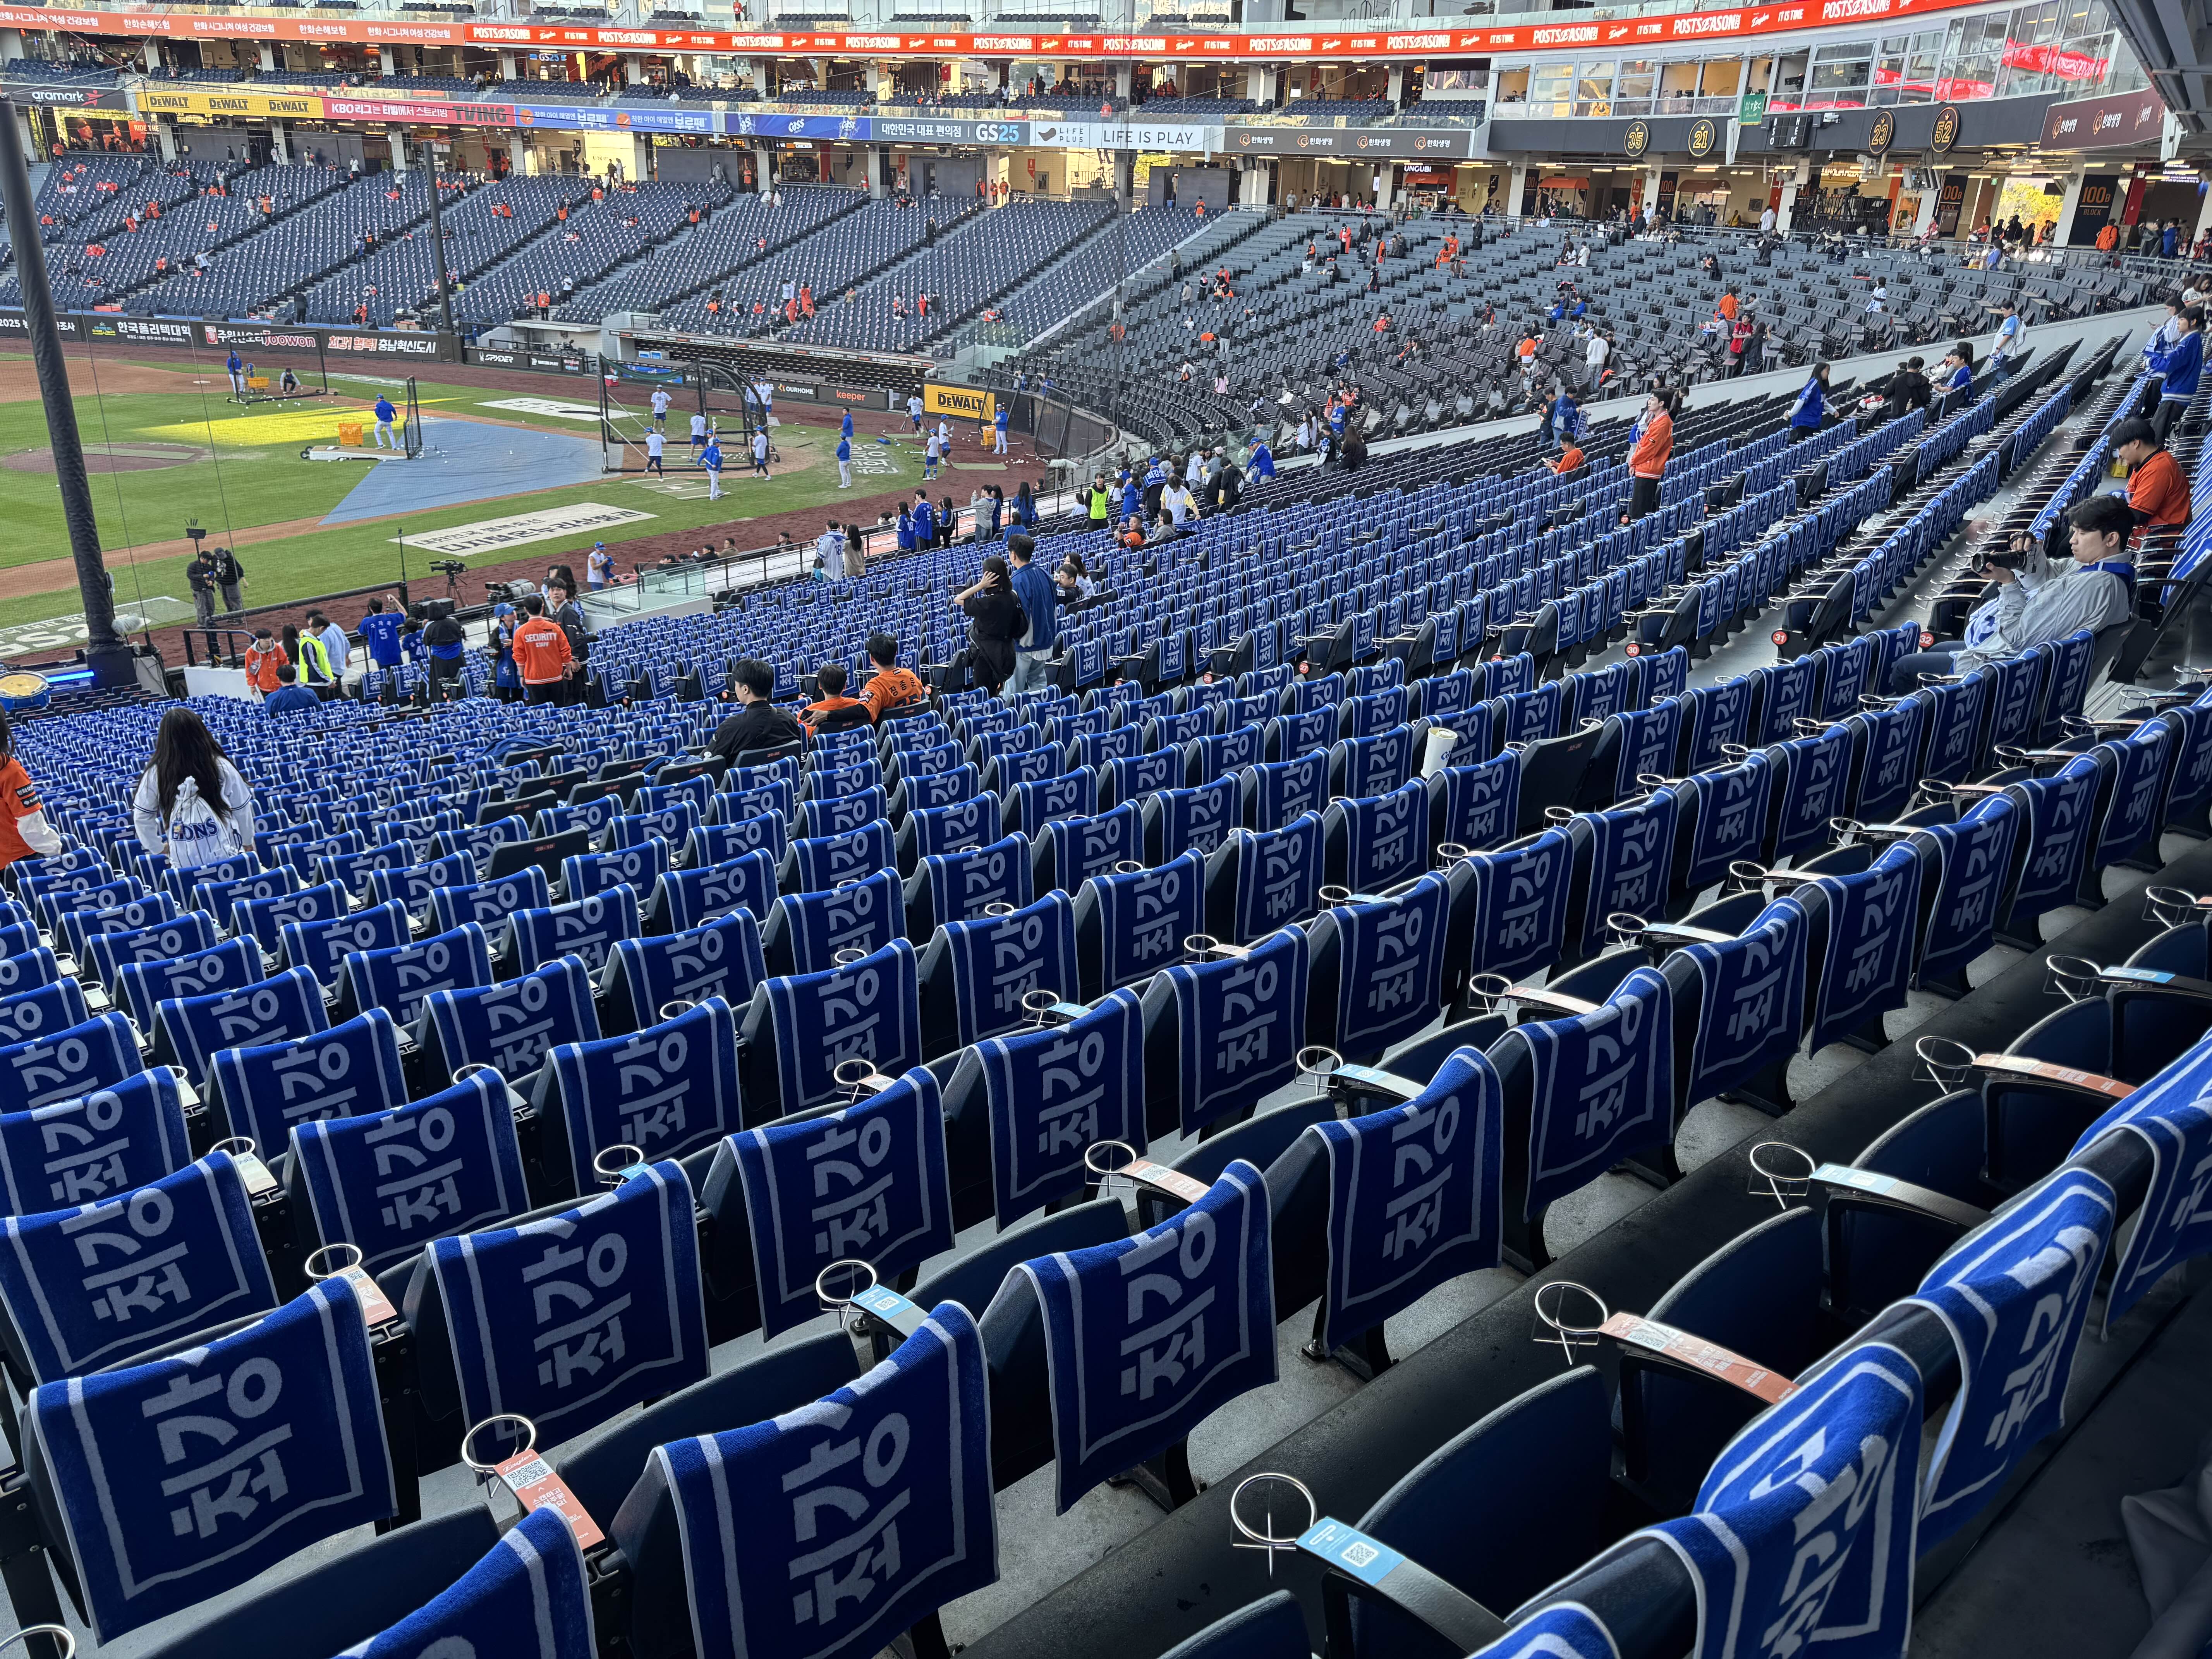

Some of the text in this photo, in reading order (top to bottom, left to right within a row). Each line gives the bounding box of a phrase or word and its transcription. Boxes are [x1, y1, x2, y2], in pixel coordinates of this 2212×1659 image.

[15, 14, 48, 23] 시그니처
[49, 15, 65, 24] 여성
[67, 16, 98, 26] 건강보험
[124, 19, 170, 30] 한화손해보험
[194, 22, 275, 33] 한화 시그니처 여성 건강보험
[1673, 16, 1735, 35] POSTSEASON
[299, 25, 346, 36] 한화손해보험
[368, 27, 450, 39] 한화 시그니처 여성 건강보험
[1533, 27, 1593, 44] POSTSEASON
[32, 91, 85, 102] aramark
[150, 96, 189, 108] DEWALT
[209, 99, 248, 110] DEWALT
[269, 101, 309, 112] DEWALT
[331, 104, 448, 117] KBO 리그는 티빙에서 스트리밍
[453, 106, 507, 123] TVING
[577, 113, 608, 128] 부루펜
[2102, 113, 2122, 129] 한화생명
[882, 123, 1019, 142] 대한민국 대표 편의점 GS25
[1104, 130, 1193, 144] LIFE IS PLAY
[1772, 127, 1775, 136] S
[1794, 127, 1798, 135] E
[1871, 124, 1889, 145] 23
[1934, 120, 1953, 143] 52
[1252, 136, 1273, 144] 한화생명
[1310, 137, 1333, 146] 한화생명
[1369, 138, 1391, 147] 한화생명
[1427, 139, 1450, 148] 한화생명
[1628, 132, 1644, 149] 35
[1693, 131, 1709, 149] 21
[1790, 136, 1796, 145] FC
[0, 319, 21, 328] 2025
[117, 321, 191, 337] 한국폴리텍대학
[265, 330, 316, 348] Joowon
[328, 335, 436, 354] 최강! 행복! 충남혁신도시
[485, 354, 514, 363] SPYDER
[785, 386, 814, 395] OURHOME
[836, 390, 865, 402] keeper
[938, 393, 983, 411] DEWALT
[926, 511, 932, 521] 5
[436, 511, 641, 551] 디지털온누리상품권
[907, 521, 914, 531] 18
[834, 544, 842, 555] 18
[378, 629, 388, 640] 5
[524, 633, 557, 643] SECURITY
[1774, 633, 1787, 643] 31
[1920, 635, 1933, 645] 32
[1628, 646, 1638, 654] 30
[1717, 761, 1757, 843] 최강
[2033, 778, 2089, 878] 최강
[1611, 816, 1659, 908] 최강
[1500, 851, 1549, 949] 최강
[1849, 872, 1901, 992] 최강
[1368, 906, 1422, 1012] 최강
[1727, 919, 1786, 1041] 최강
[1217, 960, 1278, 1073] 최강
[1575, 995, 1642, 1139] 최강
[613, 1031, 690, 1145] 최강
[1038, 1032, 1105, 1158] 최강
[365, 1107, 463, 1230] 최강
[1382, 1096, 1460, 1259] 최강
[806, 1116, 894, 1256] 최강
[59, 1188, 191, 1322] 최강
[522, 1233, 632, 1388] 최강
[1118, 1211, 1216, 1400] 최강
[142, 1357, 292, 1538] 최강
[503, 1453, 533, 1473] Eagles
[782, 1412, 910, 1626] 최강
